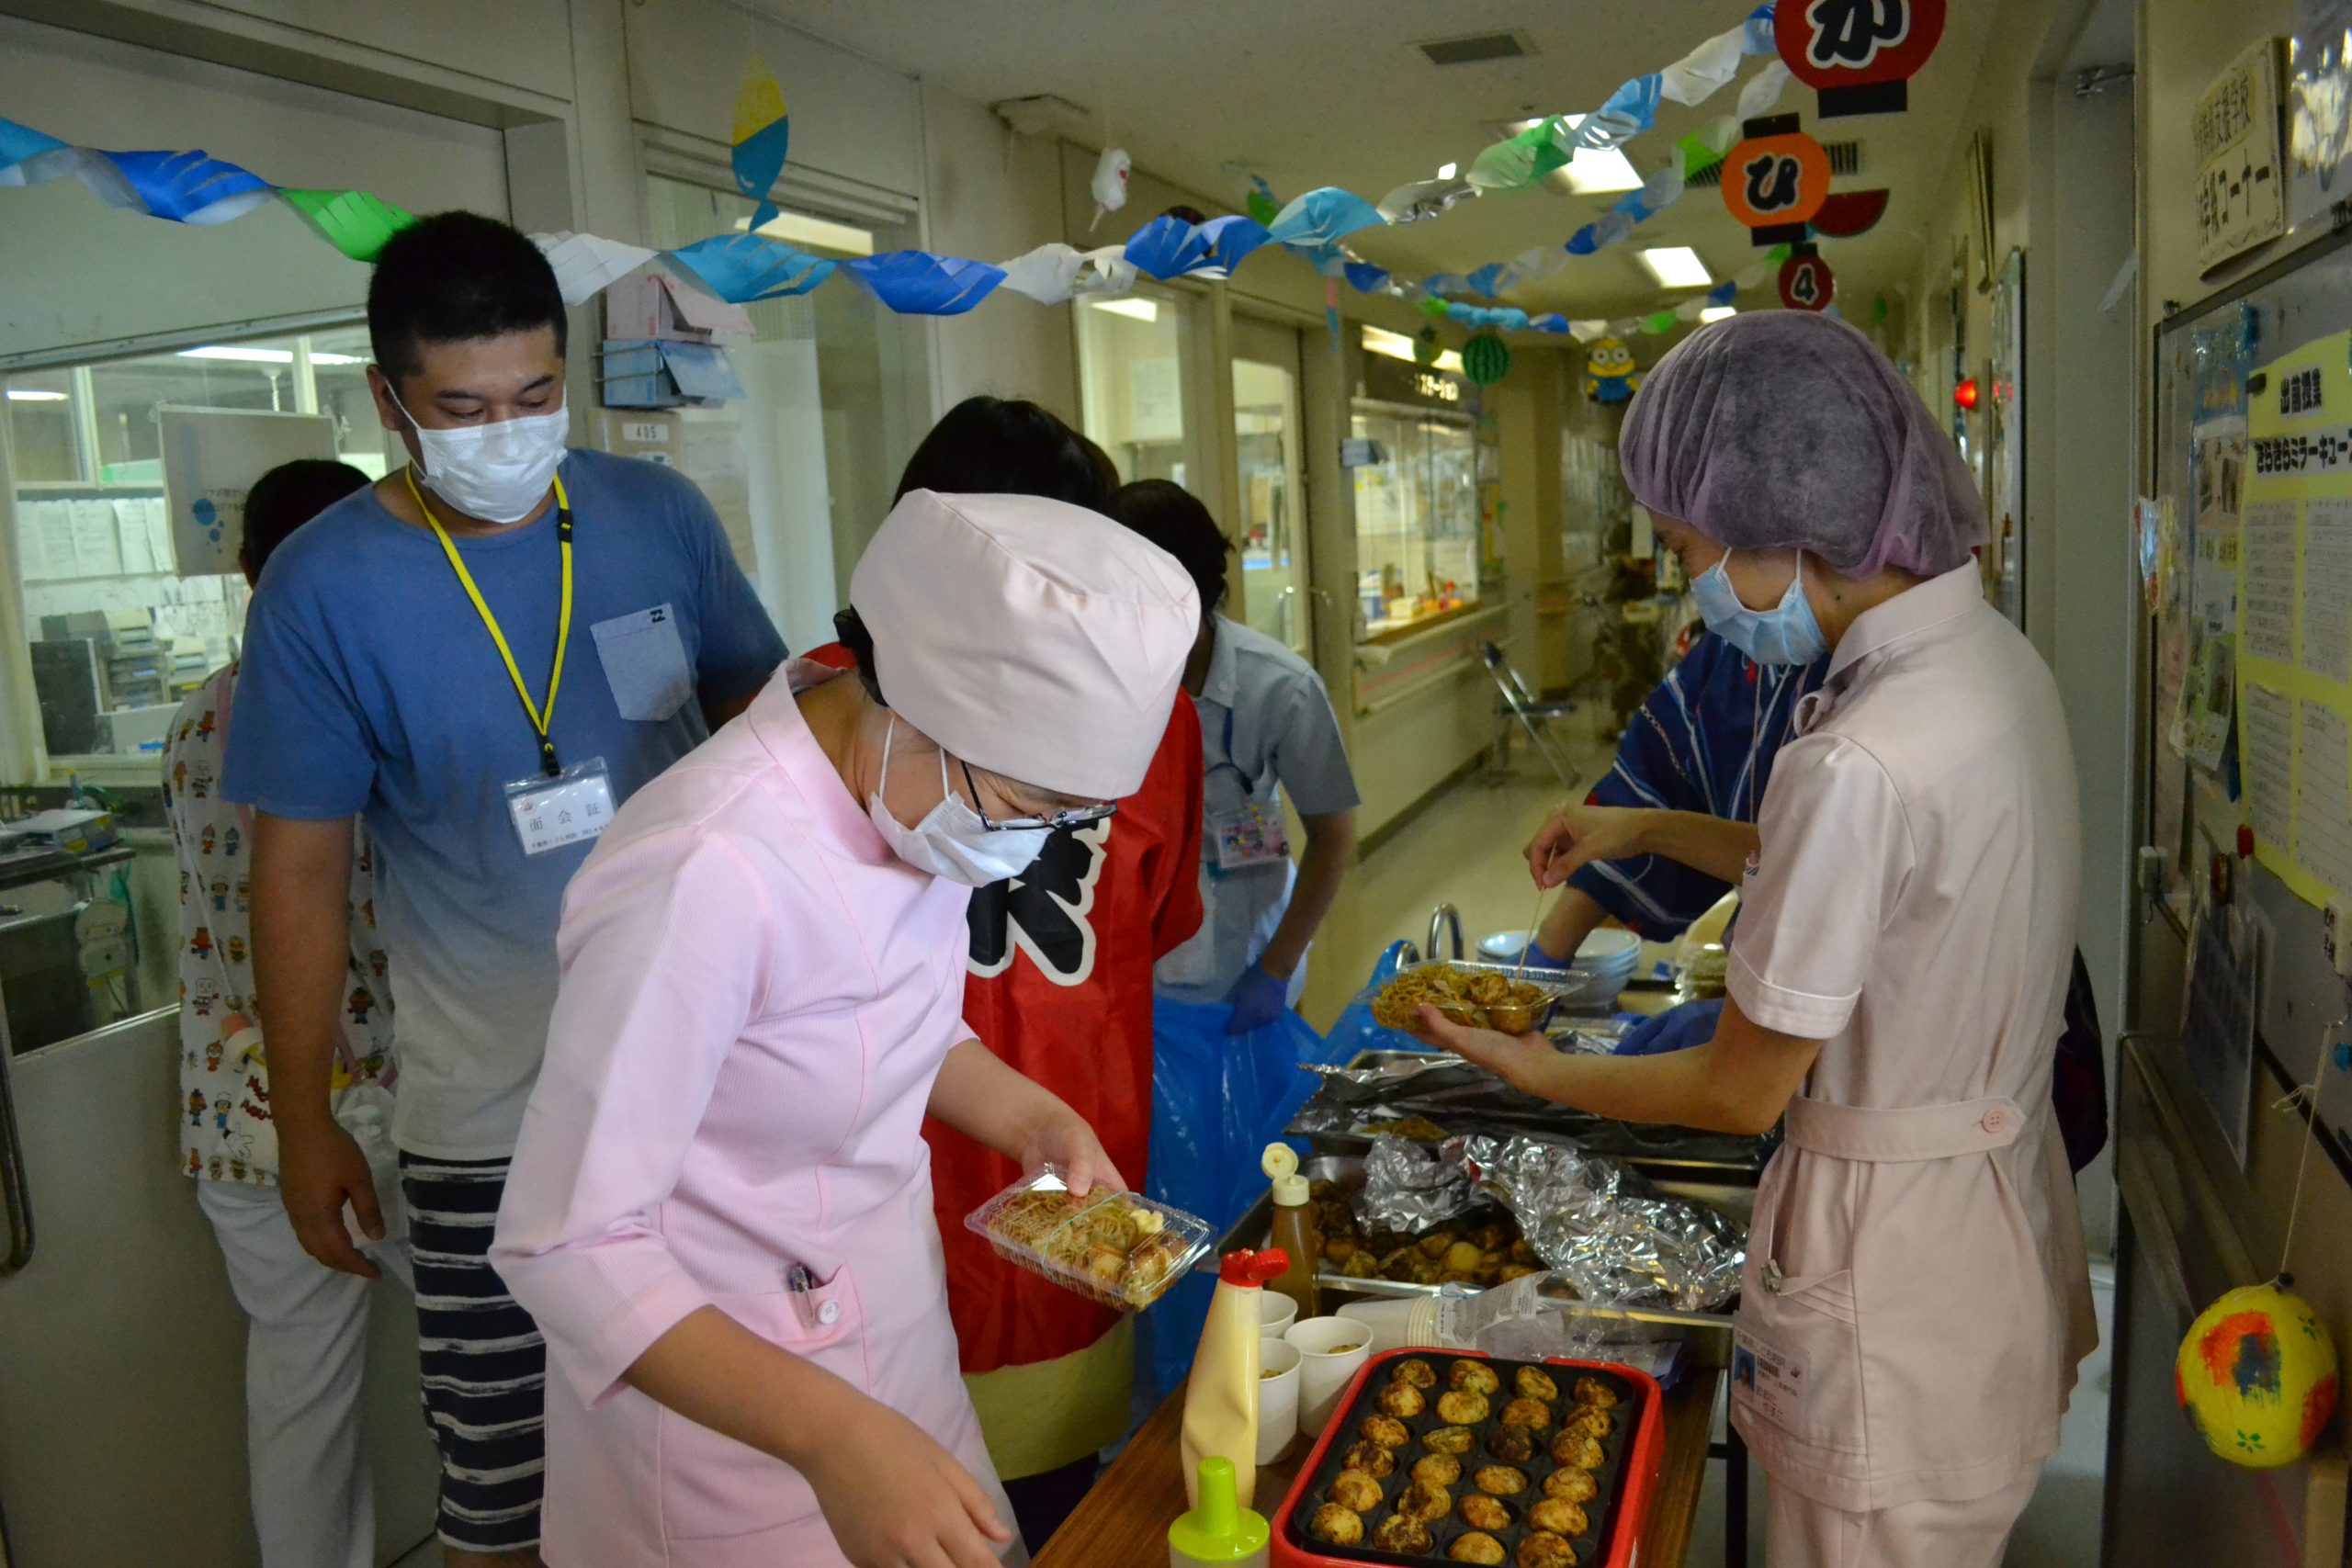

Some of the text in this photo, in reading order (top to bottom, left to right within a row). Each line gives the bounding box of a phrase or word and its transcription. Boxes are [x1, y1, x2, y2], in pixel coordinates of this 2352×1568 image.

[1745, 152, 1801, 212] ひ
[1792, 265, 1817, 302] 4
[2280, 367, 2323, 414] 出前授業
[2255, 428, 2352, 474] きらきらミラーキュー
